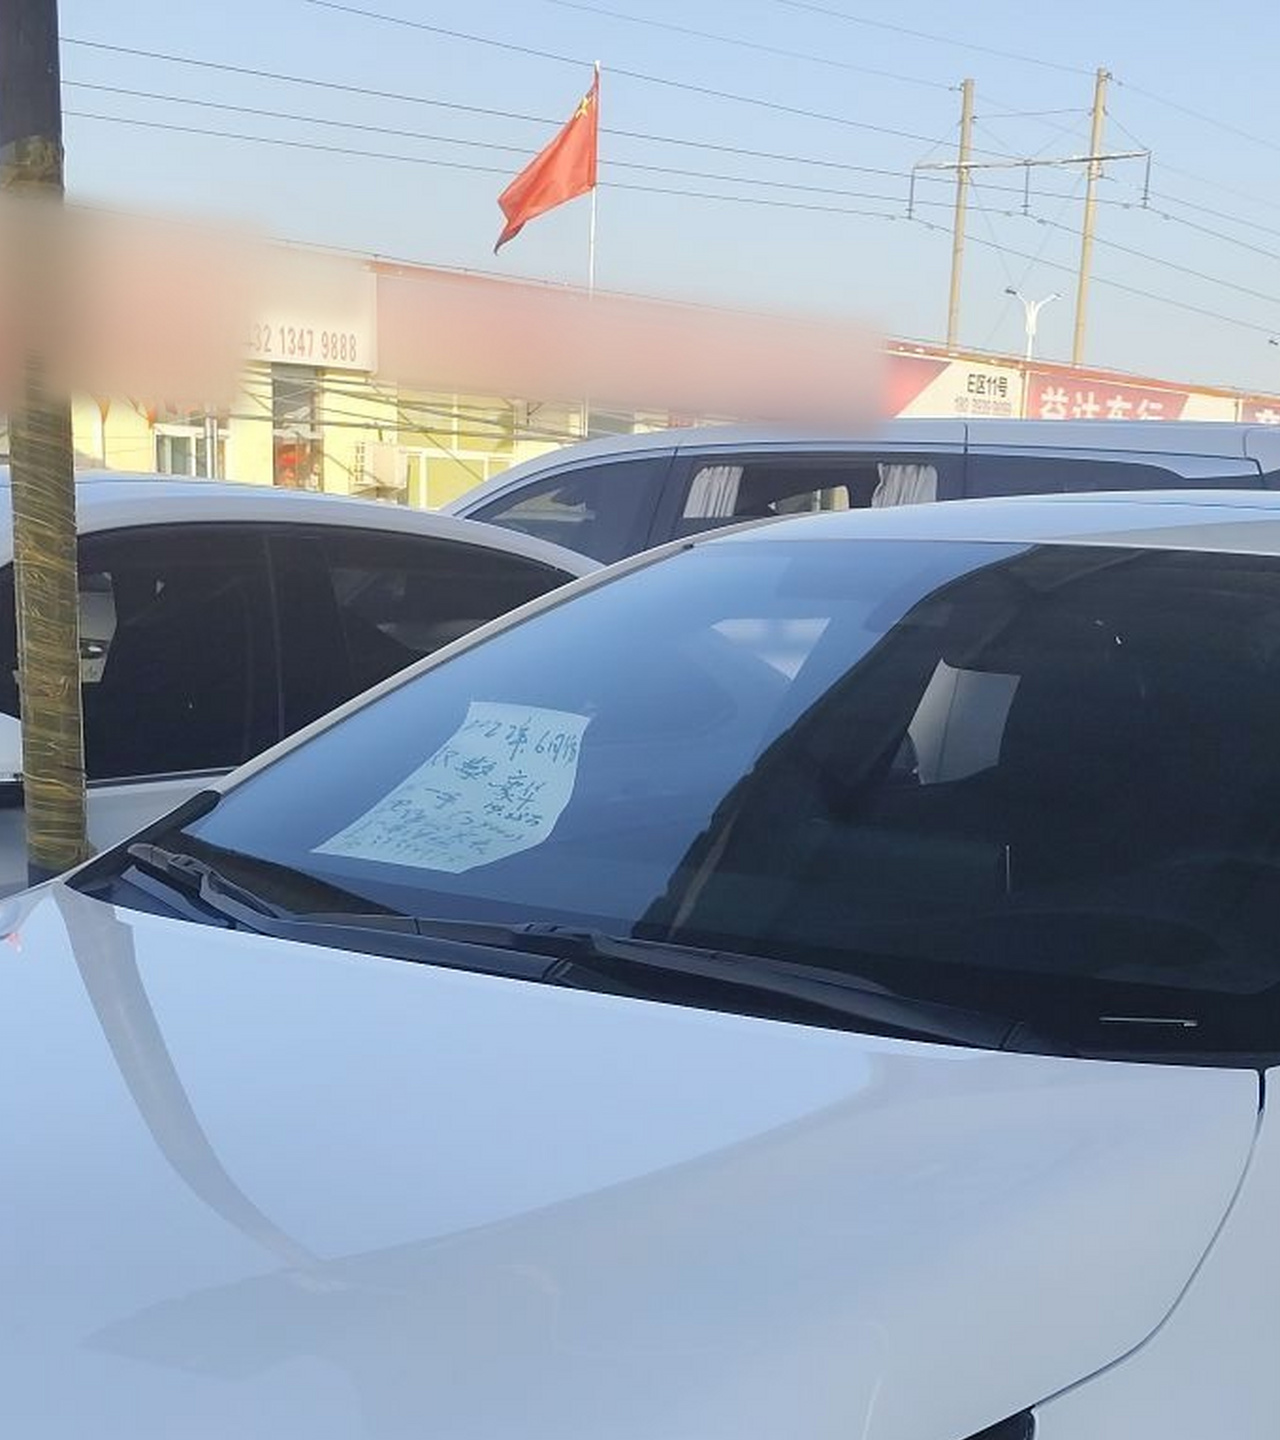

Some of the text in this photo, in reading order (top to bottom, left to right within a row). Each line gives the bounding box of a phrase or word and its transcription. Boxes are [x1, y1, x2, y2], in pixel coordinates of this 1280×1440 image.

[279, 325, 315, 358] 1347
[321, 331, 357, 361] 9888
[967, 373, 1008, 398] E区11号
